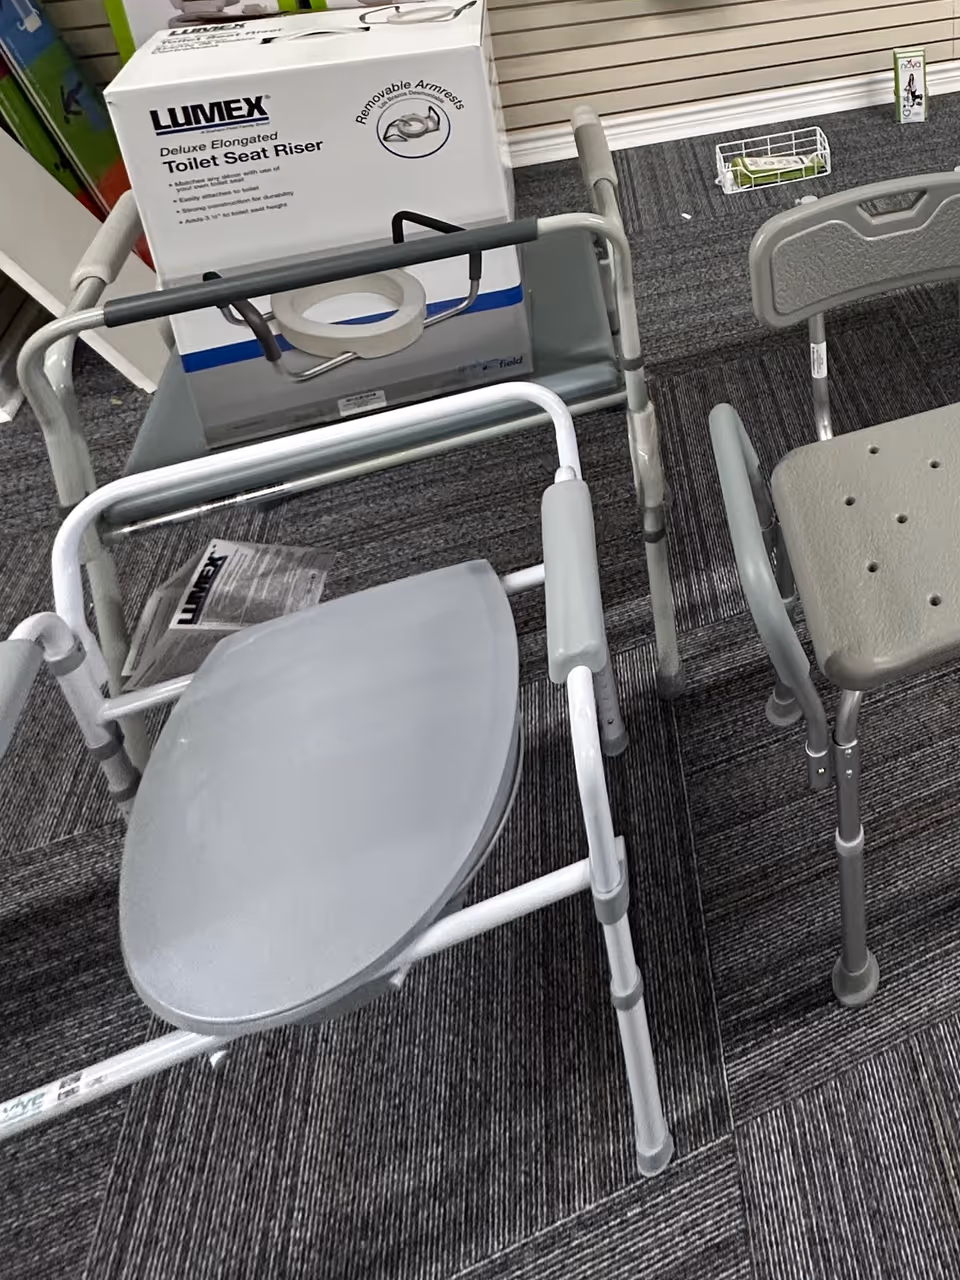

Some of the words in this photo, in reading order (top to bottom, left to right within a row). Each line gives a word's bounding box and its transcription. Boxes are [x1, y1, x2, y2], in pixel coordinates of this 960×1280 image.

[167, 22, 247, 37] LUMEX
[149, 95, 269, 131] LUMEX
[355, 80, 412, 125] Removable
[414, 79, 465, 110] Armrests
[160, 142, 207, 157] Deluxe
[211, 131, 279, 150] Elongated
[162, 153, 220, 174] Toilet
[224, 147, 270, 165] Seat
[273, 140, 324, 158] Riser
[181, 206, 207, 215] Strong
[207, 197, 251, 210] construction
[262, 190, 295, 201] durability
[177, 552, 228, 626] LUMEX
